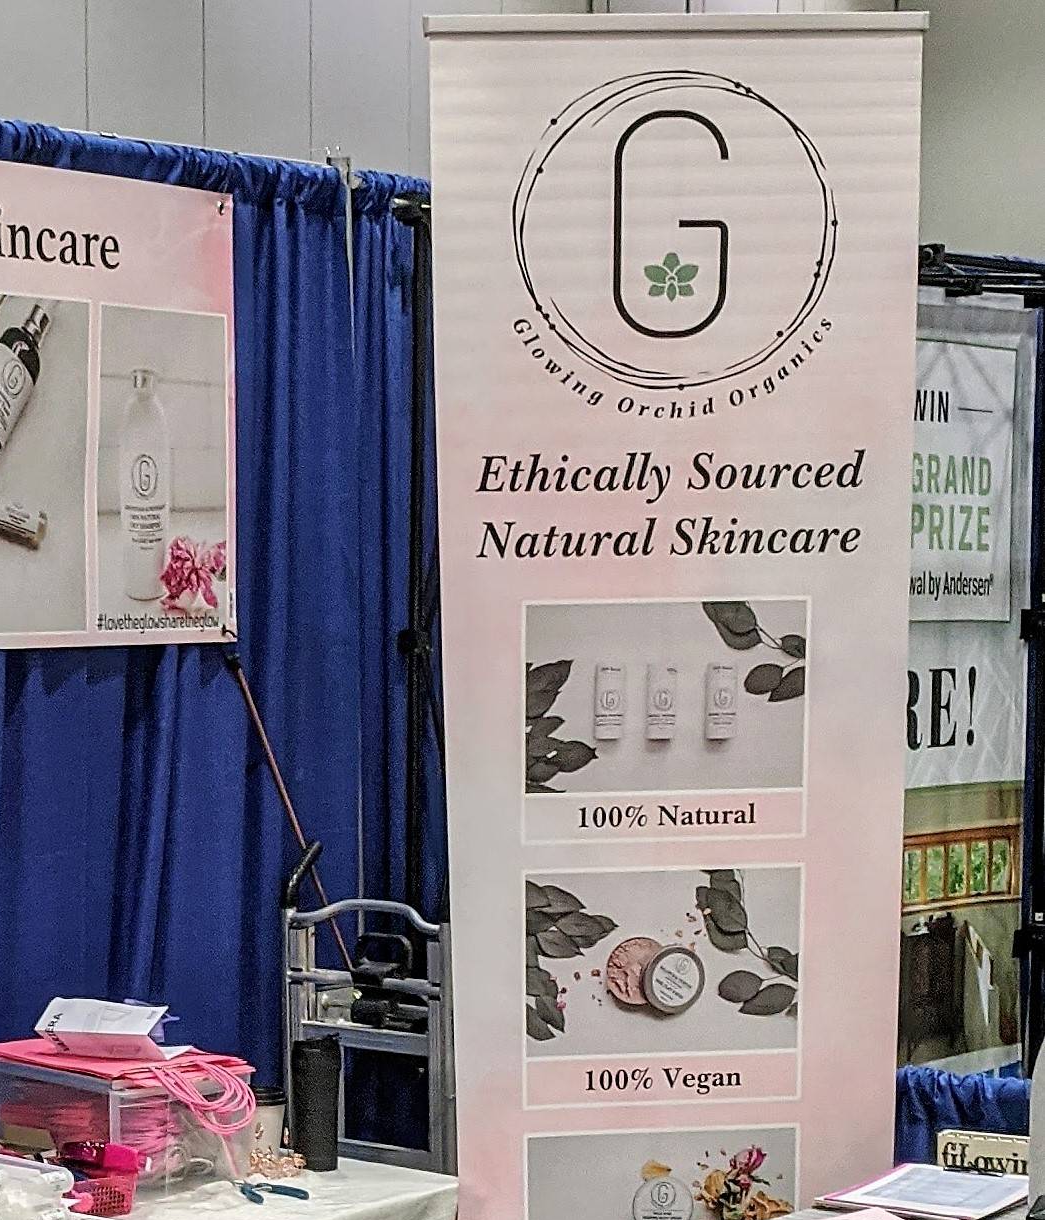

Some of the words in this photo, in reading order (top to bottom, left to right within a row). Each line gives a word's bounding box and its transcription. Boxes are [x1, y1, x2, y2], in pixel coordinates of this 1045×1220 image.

[614, 109, 728, 338] G
[512, 316, 604, 407] Glowing
[617, 395, 716, 419] Orchid
[729, 315, 834, 407] Organics
[475, 452, 671, 504] Ethically
[686, 448, 866, 490] Sourced
[912, 452, 992, 495] GRAND
[475, 519, 658, 559] Natural
[669, 517, 861, 557] Skincare
[910, 503, 990, 551] PRIZE
[929, 570, 940, 601] by
[577, 804, 648, 829] 100%
[657, 802, 757, 826] Natural
[585, 1067, 654, 1092] 100%
[662, 1067, 742, 1095] Vegan
